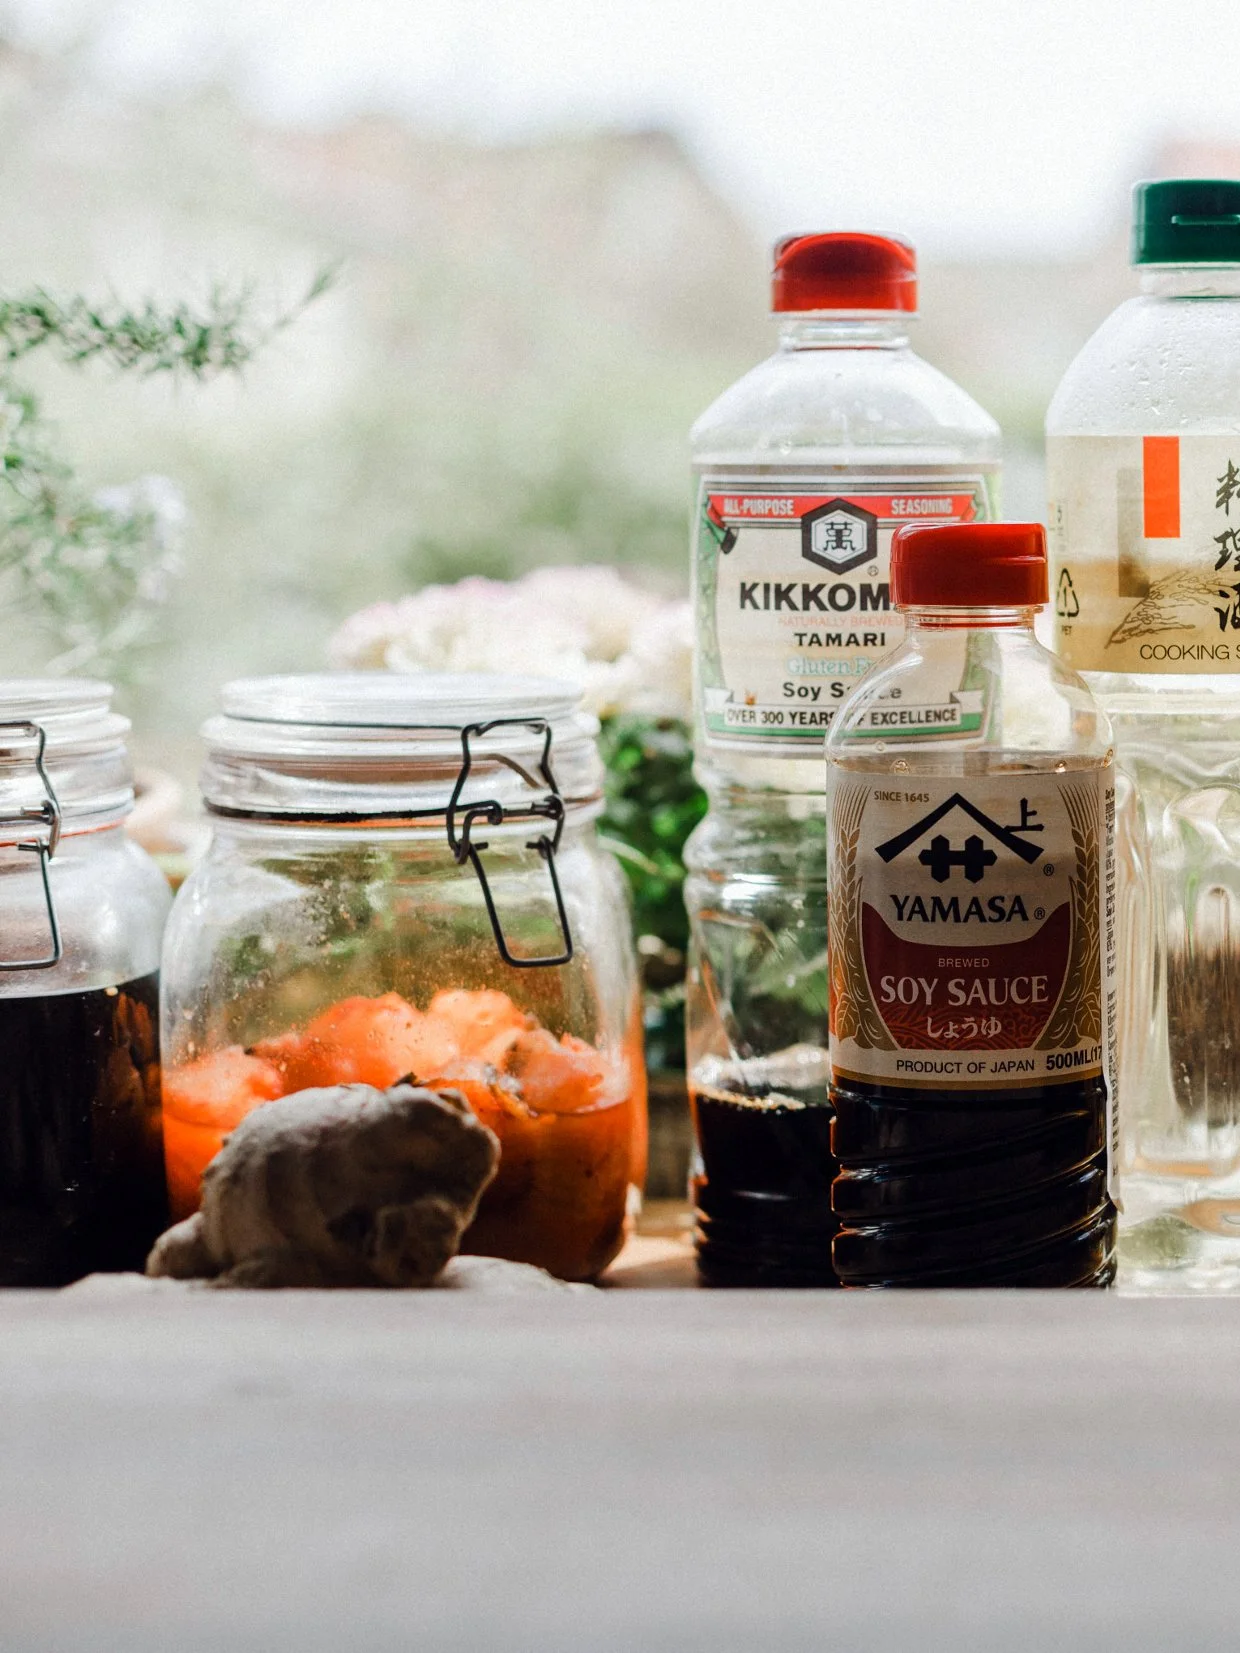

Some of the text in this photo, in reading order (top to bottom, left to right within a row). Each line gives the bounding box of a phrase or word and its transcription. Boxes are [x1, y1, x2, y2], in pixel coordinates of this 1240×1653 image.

[891, 499, 953, 515] SEASONING
[740, 582, 892, 612] KIKKOM
[794, 632, 886, 647] TAMARI
[1140, 644, 1230, 660] COOKING
[783, 682, 822, 701] Soy
[727, 709, 758, 723] OVER
[761, 711, 784, 724] 300
[871, 709, 957, 725] EXCELLENCE
[874, 790, 930, 803] SINCE 1645
[890, 895, 1029, 923] YAMASA
[938, 958, 990, 968] BREWED
[880, 974, 1048, 1007] SOY SAUCE
[926, 1016, 1002, 1039] しょうゆ
[896, 1059, 1035, 1074] PRODUCT OF JAPAN
